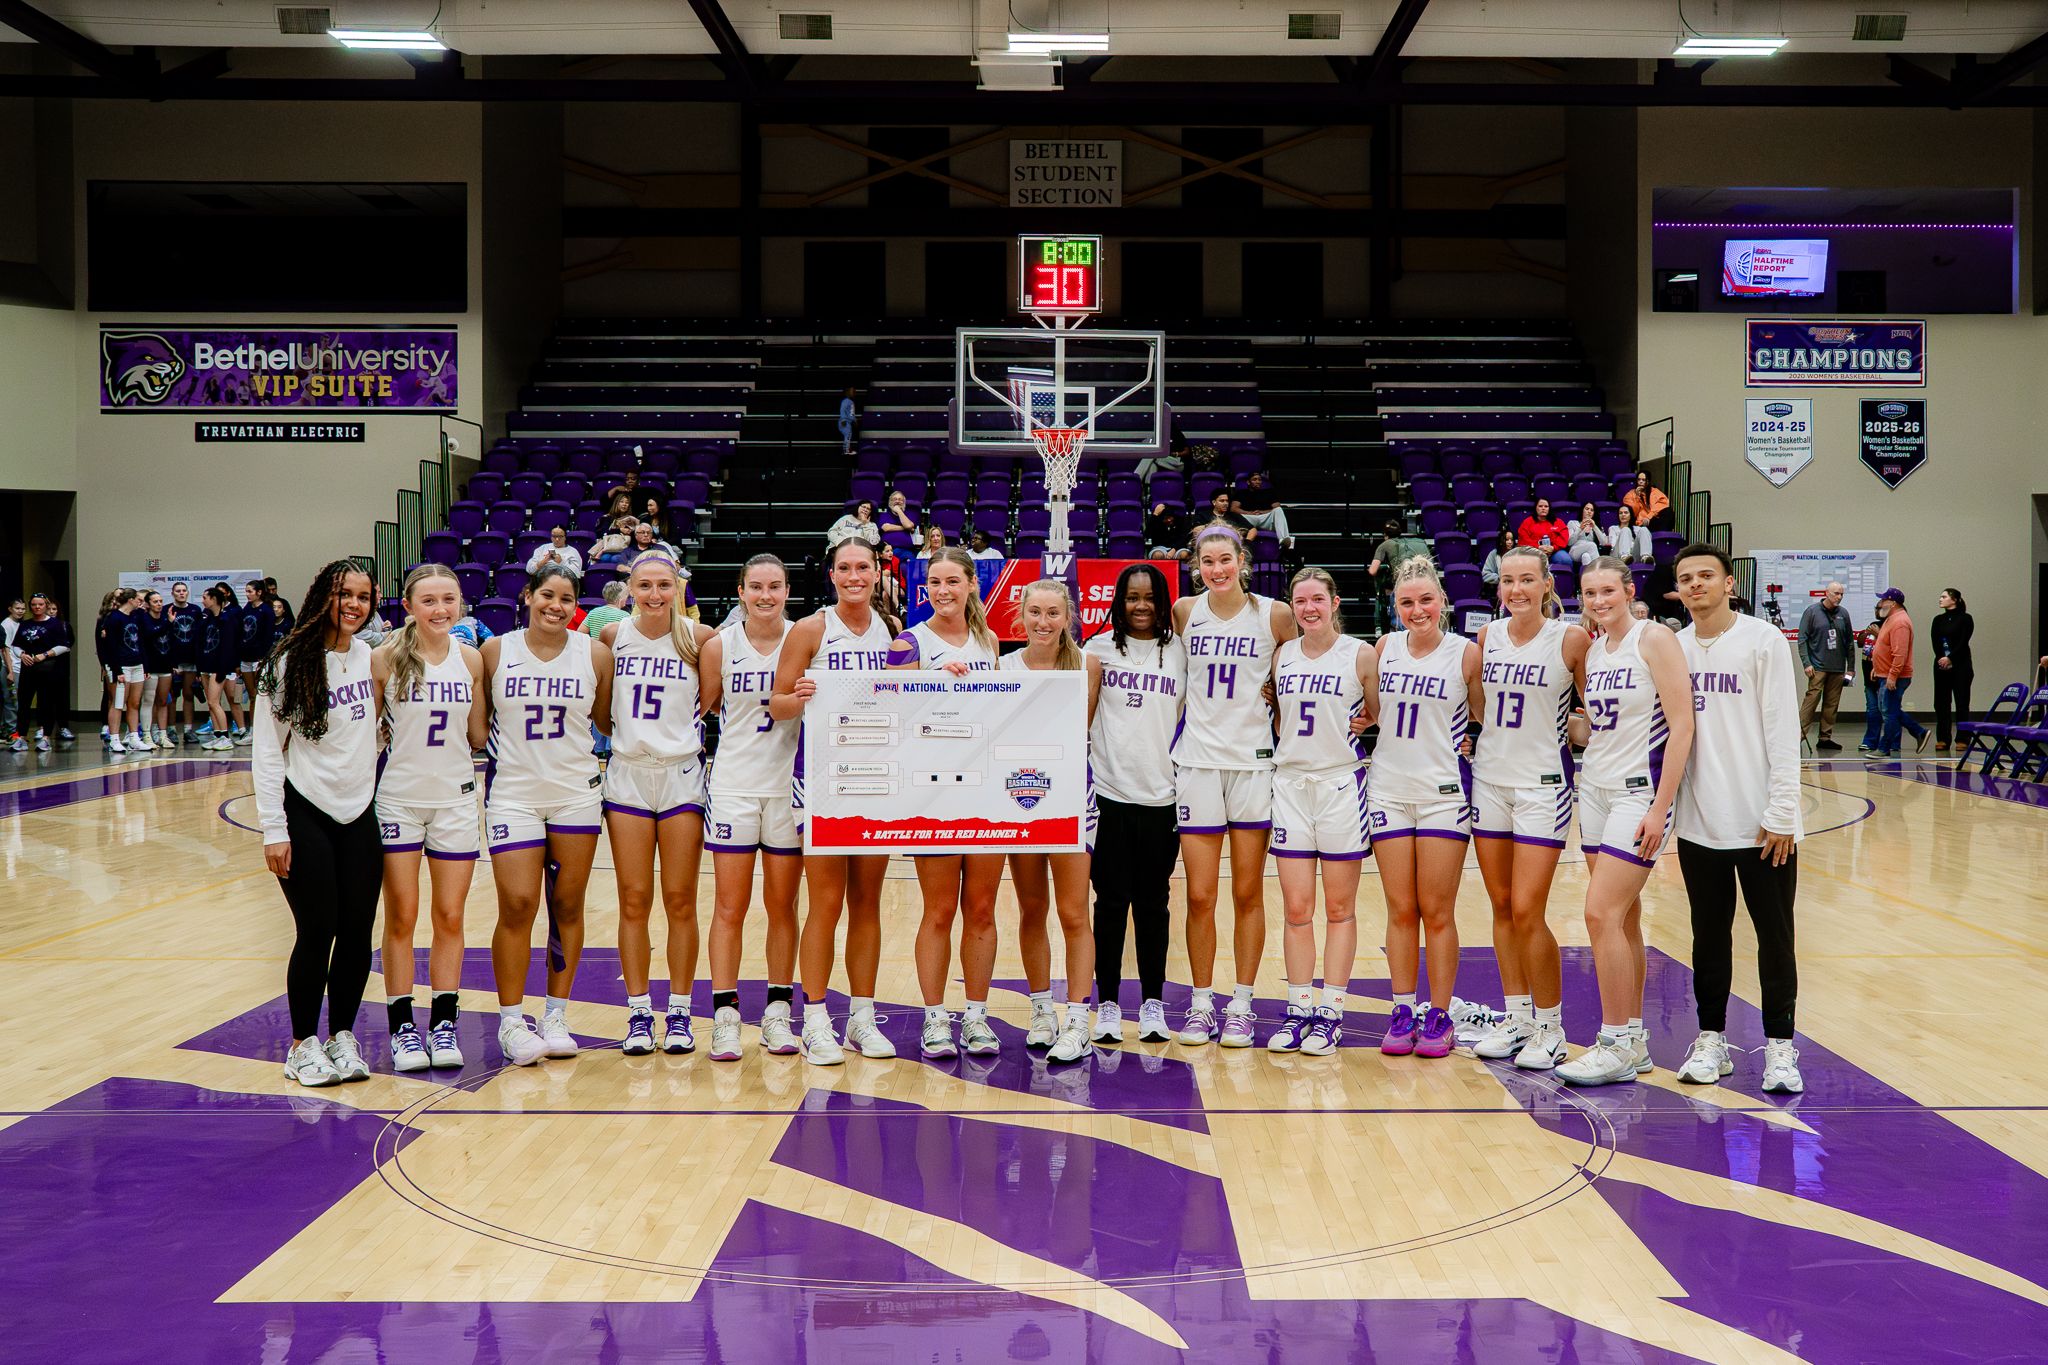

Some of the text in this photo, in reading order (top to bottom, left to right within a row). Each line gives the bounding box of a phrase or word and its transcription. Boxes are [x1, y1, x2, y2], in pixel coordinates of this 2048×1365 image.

[1025, 143, 1108, 159] BETHEL
[1014, 166, 1117, 182] STUDENT
[1018, 188, 1114, 205] SECTION
[1043, 242, 1092, 265] 8:00
[1036, 267, 1084, 305] 30
[1755, 348, 1912, 369] CHAMPIONS
[252, 375, 393, 397] VIP SUITE
[202, 426, 360, 438] TREVATHAN ELECTRIC
[1751, 421, 1806, 432] 2024-25
[1865, 421, 1920, 433] 2025-26
[1747, 436, 1811, 444] Women's Basketball
[1862, 435, 1924, 444] Women's Basketball
[1190, 636, 1259, 658] BETHEL
[615, 656, 688, 681] BETHEL
[828, 650, 887, 670] BETHE
[1102, 669, 1177, 698] LOCK IT IN.
[1207, 663, 1237, 699] 14
[1278, 674, 1344, 697] BETHEL
[1379, 672, 1448, 700] BETHEL
[1482, 662, 1548, 687] BETHEL
[1585, 668, 1637, 692] ETHEL
[1703, 672, 1717, 692] IT
[1718, 673, 1742, 695] IN.
[327, 683, 359, 710] OCK
[356, 679, 370, 700] IT
[505, 677, 584, 699] BETHEL
[874, 683, 1022, 694] NAIA NATIONAL CHAMPIONSHIP
[632, 684, 665, 720] 15
[1496, 691, 1526, 729] 13
[426, 709, 449, 747] 2
[524, 704, 567, 741] 23
[1297, 701, 1316, 737] 5
[1396, 702, 1420, 739] 11
[1007, 779, 1049, 788] BASKETBALL
[873, 829, 1018, 839] BATTLE FOR THE RED BANNER
